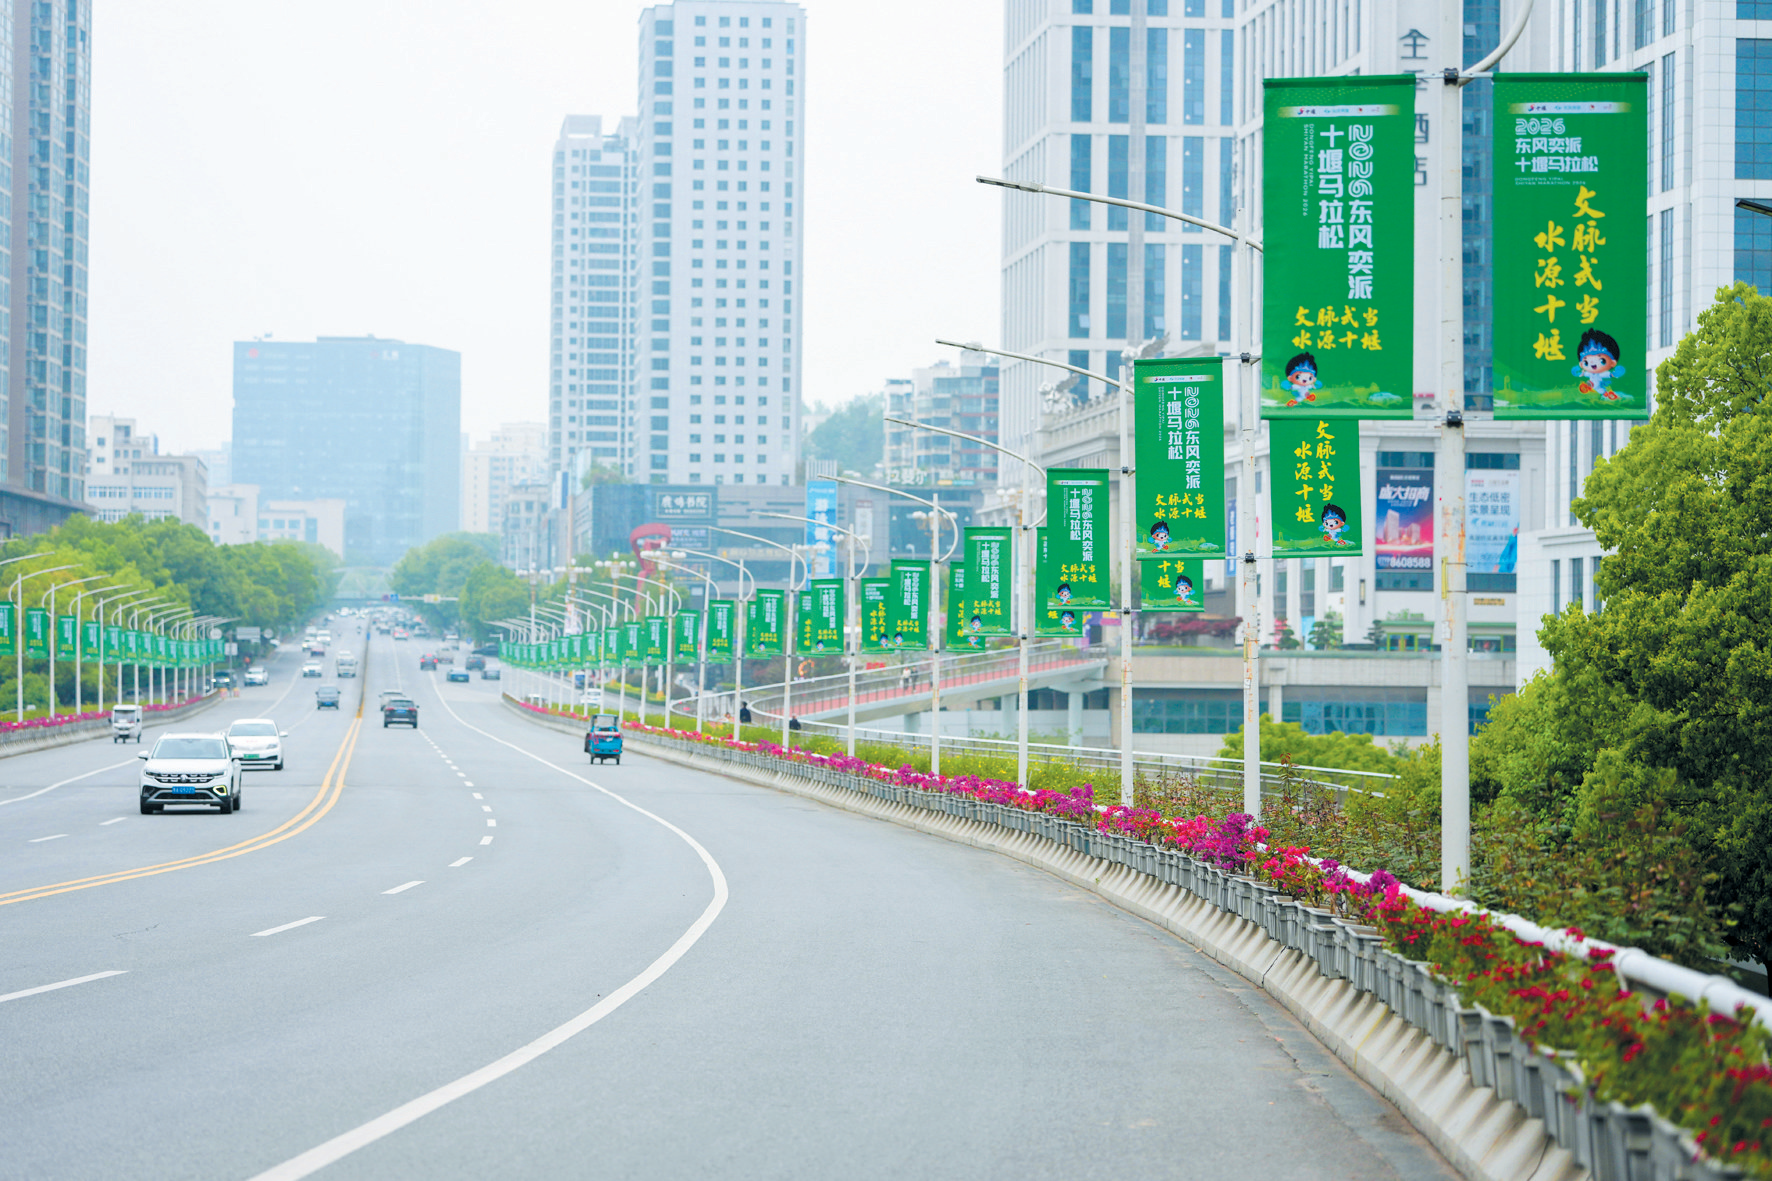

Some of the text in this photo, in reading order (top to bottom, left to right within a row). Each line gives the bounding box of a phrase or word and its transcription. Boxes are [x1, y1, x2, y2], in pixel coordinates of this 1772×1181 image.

[1516, 118, 1565, 134] 2026
[1516, 138, 1581, 153] 东风奕派
[1318, 125, 1344, 248] 十堰马拉松
[1515, 157, 1597, 172] 十堰马拉松
[1533, 221, 1565, 360] 水源十堰
[1292, 330, 1382, 350] 水源十堰
[1167, 387, 1183, 459] 十堰马拉松
[1294, 441, 1315, 522] 水源十堰
